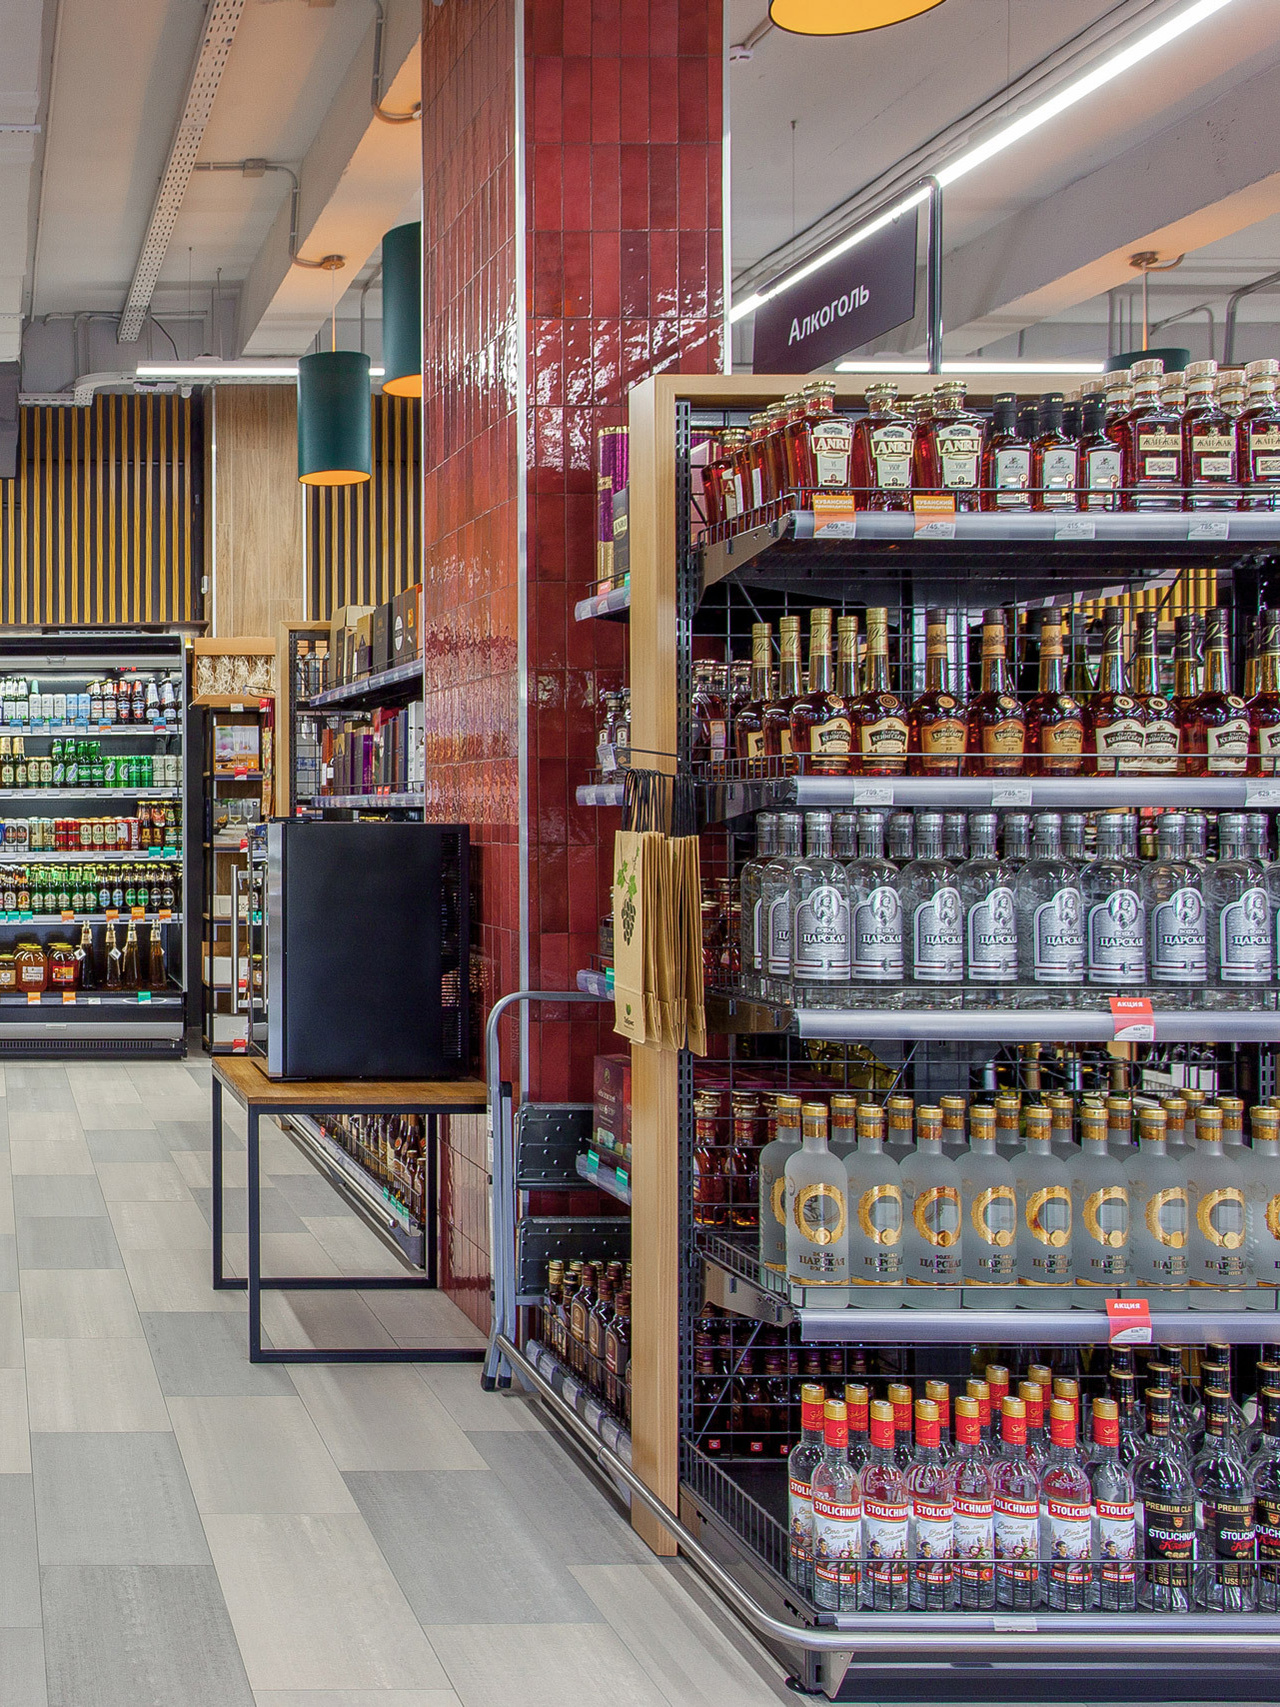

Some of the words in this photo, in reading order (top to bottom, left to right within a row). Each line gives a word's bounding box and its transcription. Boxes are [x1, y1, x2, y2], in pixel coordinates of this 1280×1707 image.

[788, 284, 870, 346] Алкоголь
[816, 438, 850, 450] ANRI
[876, 441, 911, 454] ANRI
[942, 439, 978, 452] ANRI
[803, 934, 846, 945] ЦАРСКАЯ
[1100, 937, 1144, 947] ЦАРСКАЯ
[799, 1255, 845, 1266] ЦАРСКАЯ
[1145, 1501, 1174, 1512] PREMIUM
[1217, 1503, 1249, 1513] PREMIUM
